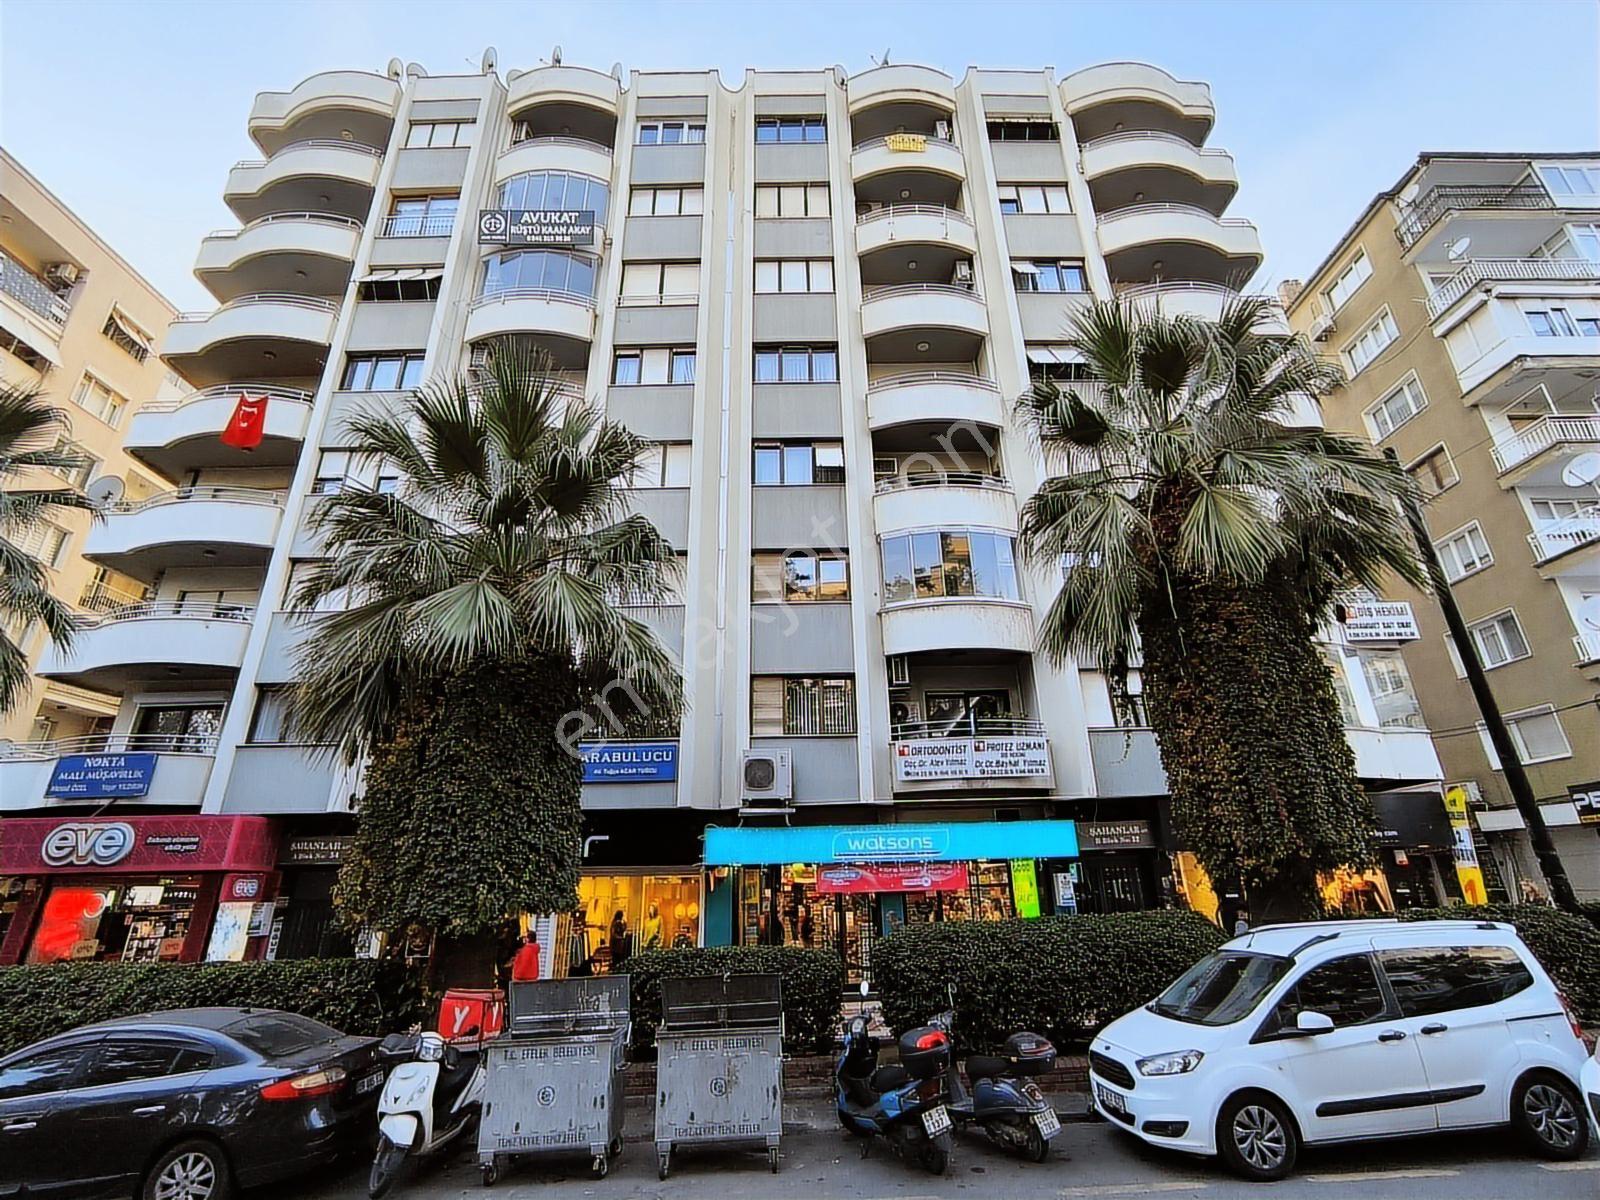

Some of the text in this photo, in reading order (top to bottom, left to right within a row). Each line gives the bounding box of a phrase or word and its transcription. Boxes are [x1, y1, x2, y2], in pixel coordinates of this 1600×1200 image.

[520, 212, 579, 224] AVUKAT
[541, 225, 567, 234] KAAN
[911, 744, 967, 756] ORTODONTİST
[986, 741, 1045, 751] PROTEZ UZMANI
[84, 757, 125, 767] NOKTA
[46, 826, 131, 861] eve
[848, 836, 933, 850] watsons
[234, 879, 259, 897] eve
